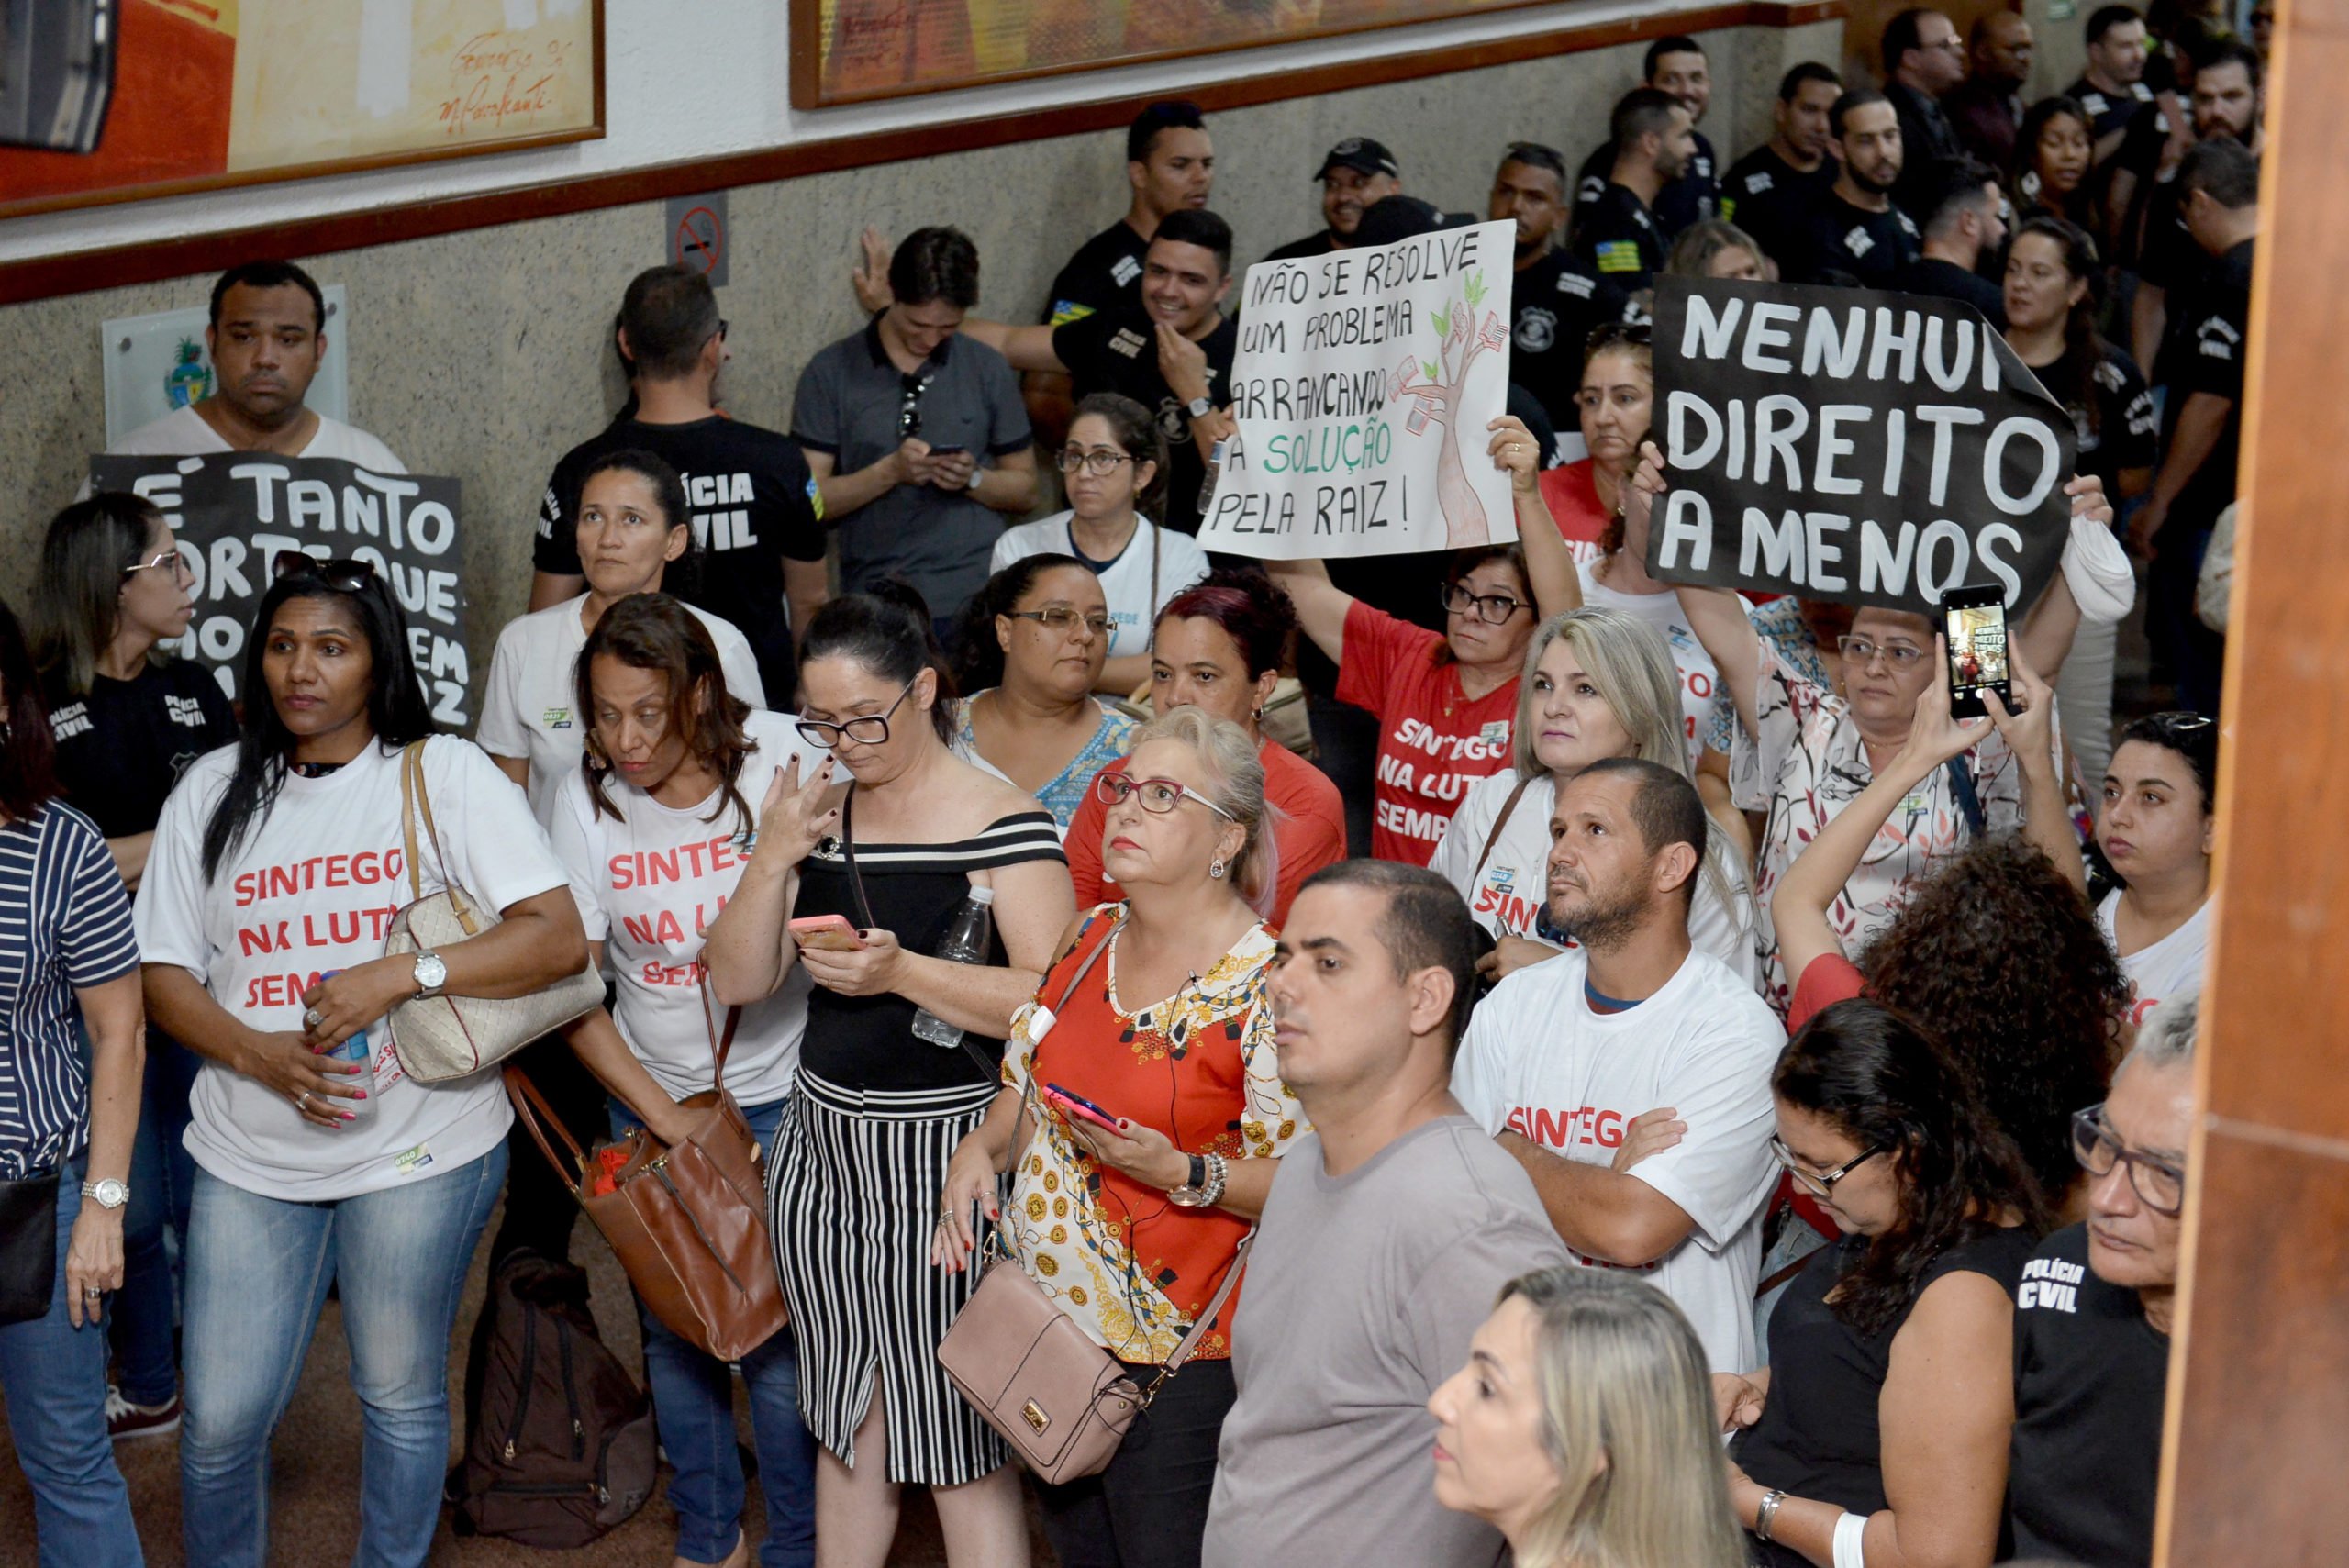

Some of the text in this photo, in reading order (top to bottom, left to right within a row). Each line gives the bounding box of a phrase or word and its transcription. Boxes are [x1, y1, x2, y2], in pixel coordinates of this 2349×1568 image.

[1251, 231, 1479, 307] NÃO SE RESOLVE
[1244, 299, 1412, 353] UM PROBLEMA
[1232, 368, 1386, 421] ARRANCANDO
[1228, 416, 1391, 475] A SOLUÇÃO
[1666, 390, 2061, 516] DIREITO
[133, 457, 456, 556] É TANTO
[682, 472, 755, 506] ÍCIA
[1210, 492, 1295, 535] PELA
[1658, 488, 2023, 610] A MENOS
[1377, 754, 1485, 801] NA LUT
[1377, 799, 1452, 842] SEMP
[234, 849, 403, 906] SINTEGO
[608, 834, 751, 890] SINTE
[303, 904, 396, 948] LUT
[622, 909, 685, 946] NA
[245, 969, 335, 1008] SEM
[2021, 1257, 2085, 1284] POLÍCIA
